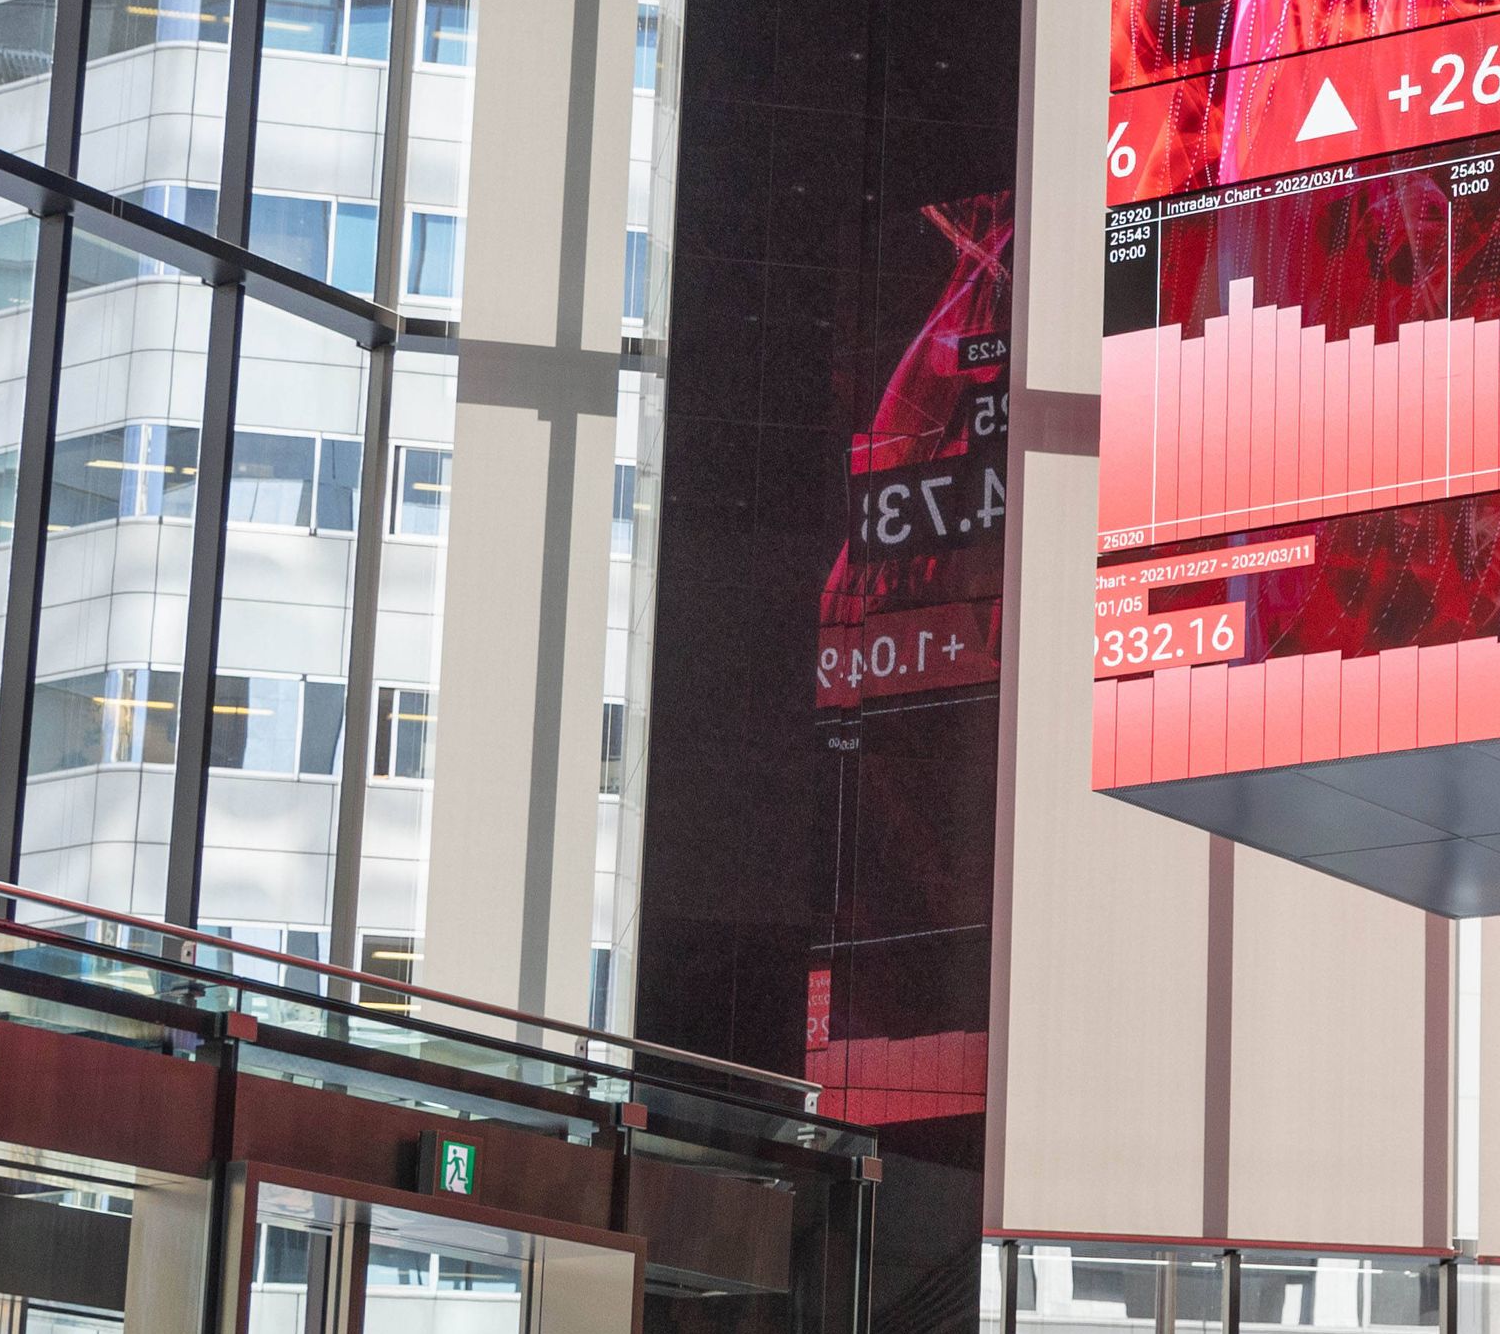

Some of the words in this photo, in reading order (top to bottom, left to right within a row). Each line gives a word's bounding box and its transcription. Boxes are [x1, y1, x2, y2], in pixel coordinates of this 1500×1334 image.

[1450, 158, 1495, 180] 25430
[1167, 194, 1221, 216] Intraday
[1225, 184, 1262, 204] Chart
[1275, 167, 1354, 194] 2022/03/14
[1450, 177, 1490, 196] 10:00
[1111, 207, 1151, 226] 25920
[1110, 226, 1150, 246] 25543
[1110, 244, 1146, 263] 09:00
[1103, 531, 1145, 550] 25020
[1140, 559, 1217, 584] 2021/12/27
[1232, 545, 1310, 570] 2022/03/11
